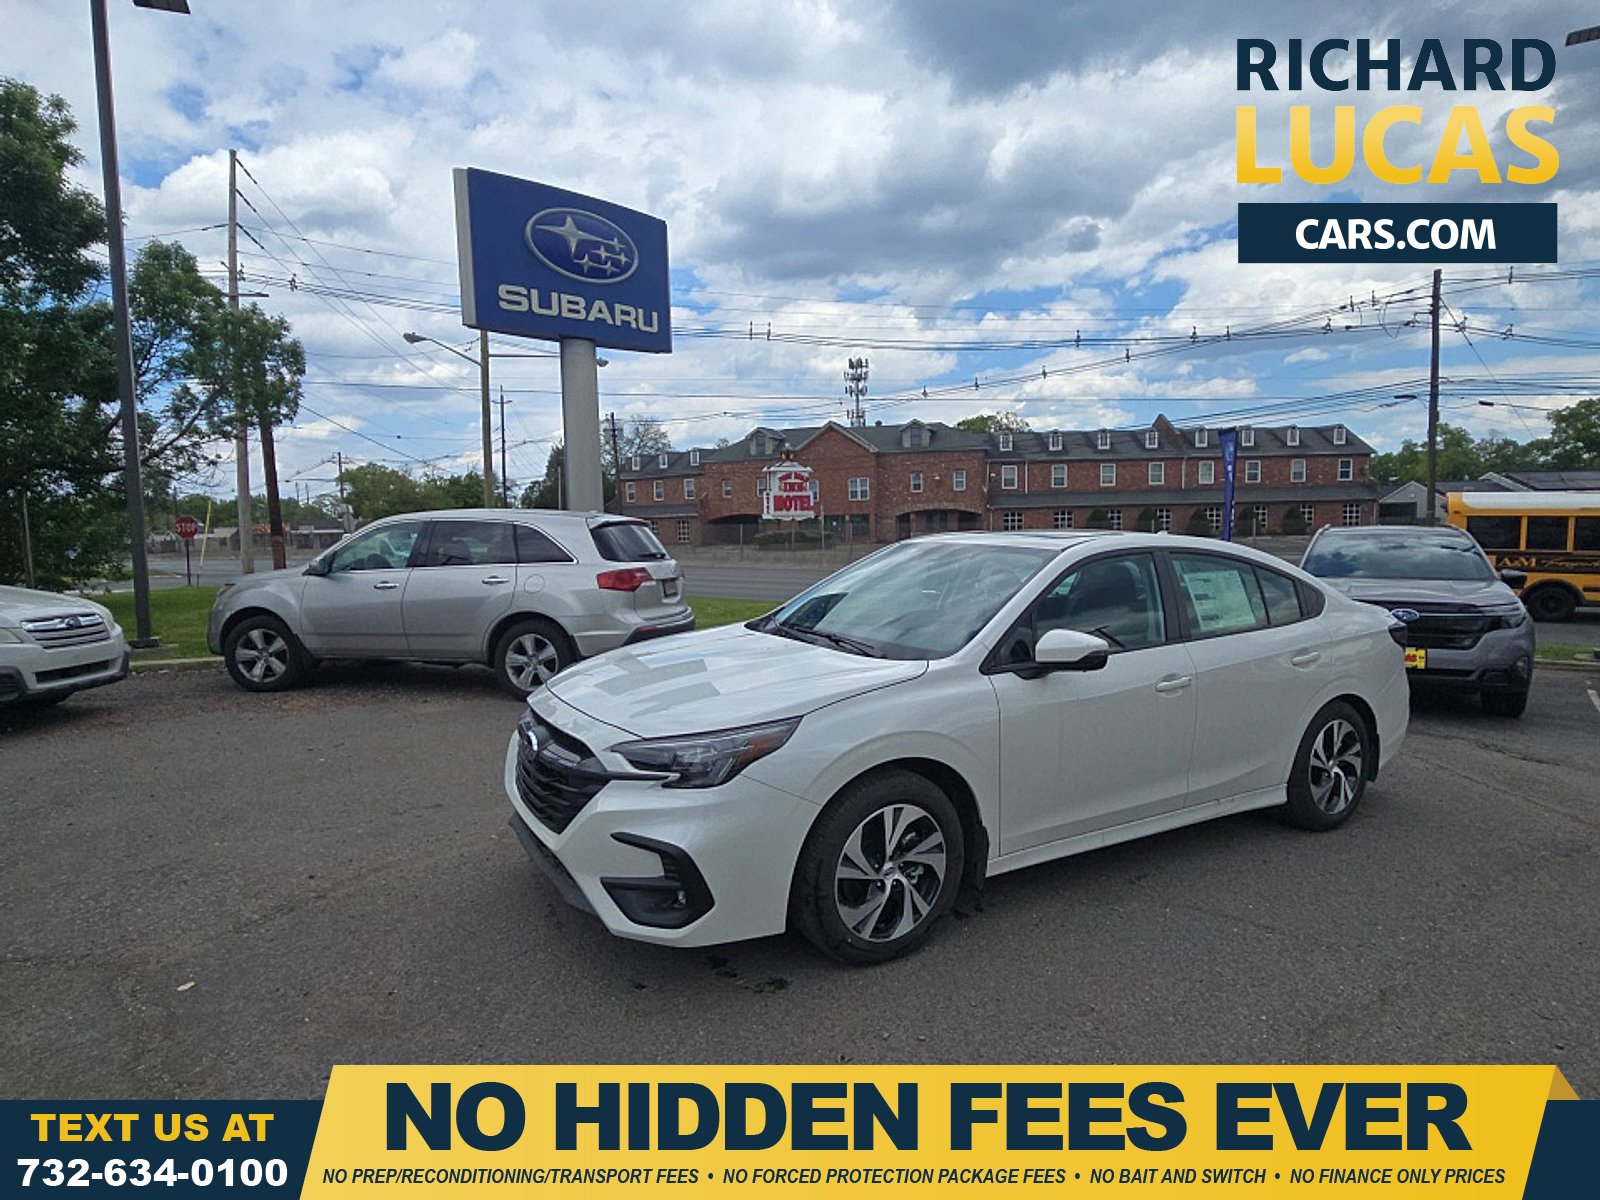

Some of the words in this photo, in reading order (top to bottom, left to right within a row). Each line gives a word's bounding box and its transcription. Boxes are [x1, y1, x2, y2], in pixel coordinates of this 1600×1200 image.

[498, 284, 658, 333] SUBARU
[773, 495, 816, 512] MOTEL
[175, 522, 197, 533] STOP
